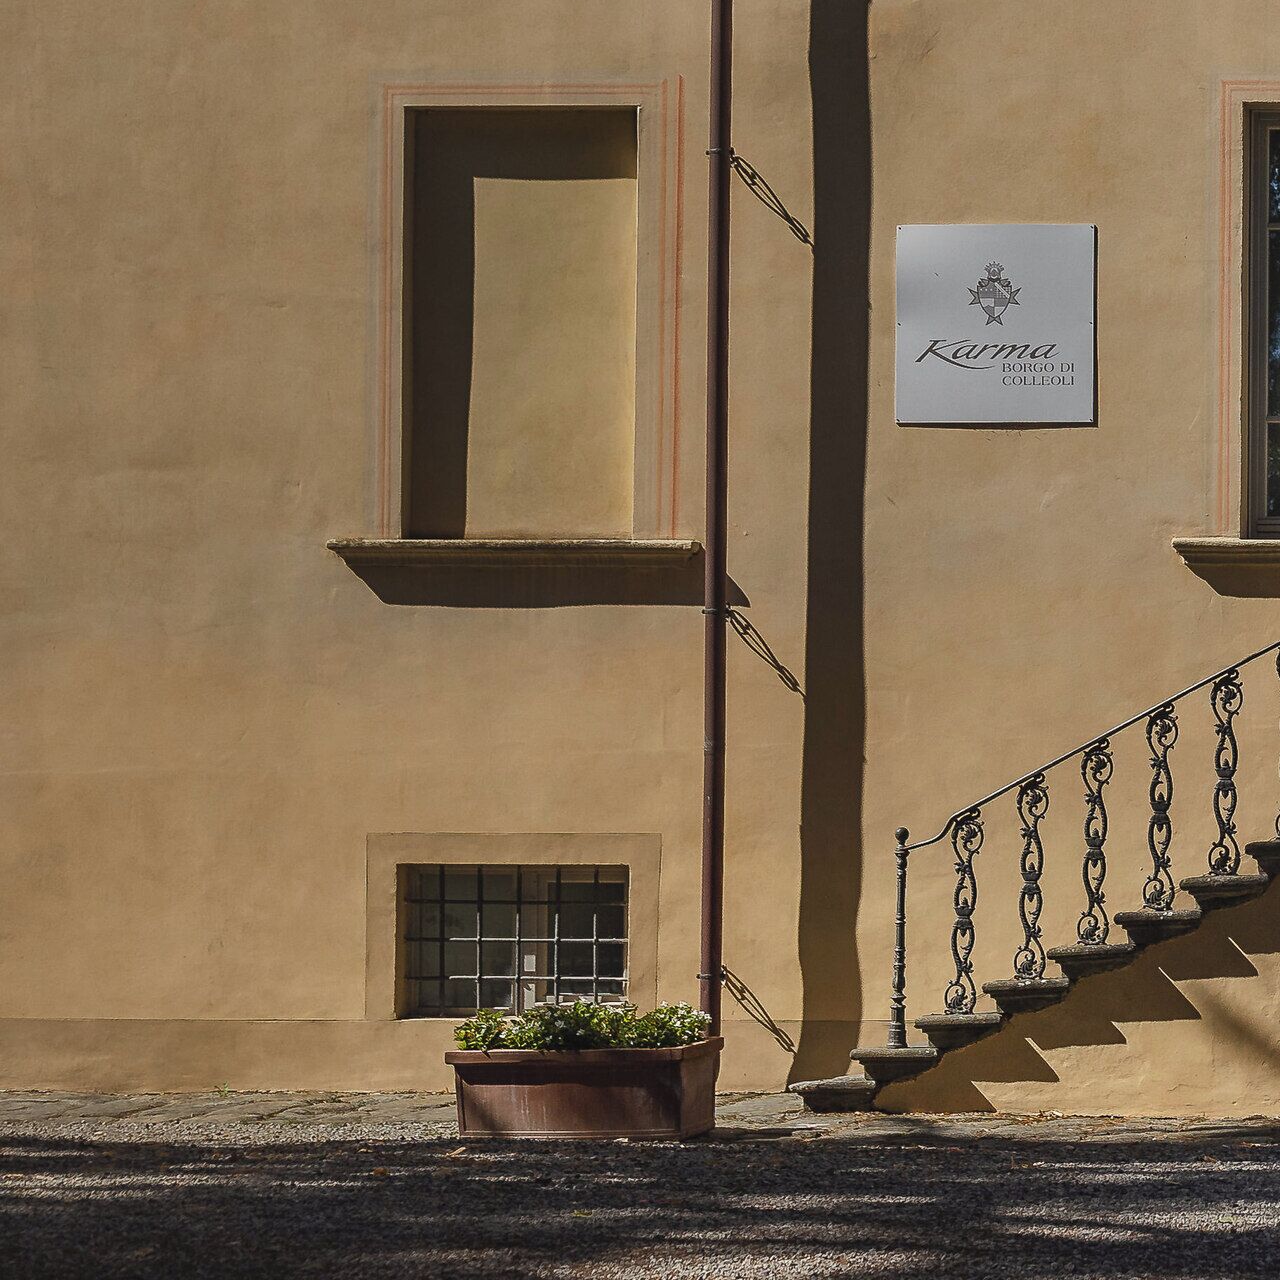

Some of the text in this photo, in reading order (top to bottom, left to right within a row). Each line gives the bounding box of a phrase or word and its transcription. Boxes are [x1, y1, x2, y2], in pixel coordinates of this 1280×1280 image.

[914, 339, 1060, 370] Karma
[1002, 362, 1075, 373] BORGO DI
[1002, 375, 1075, 386] COLLEOLI
